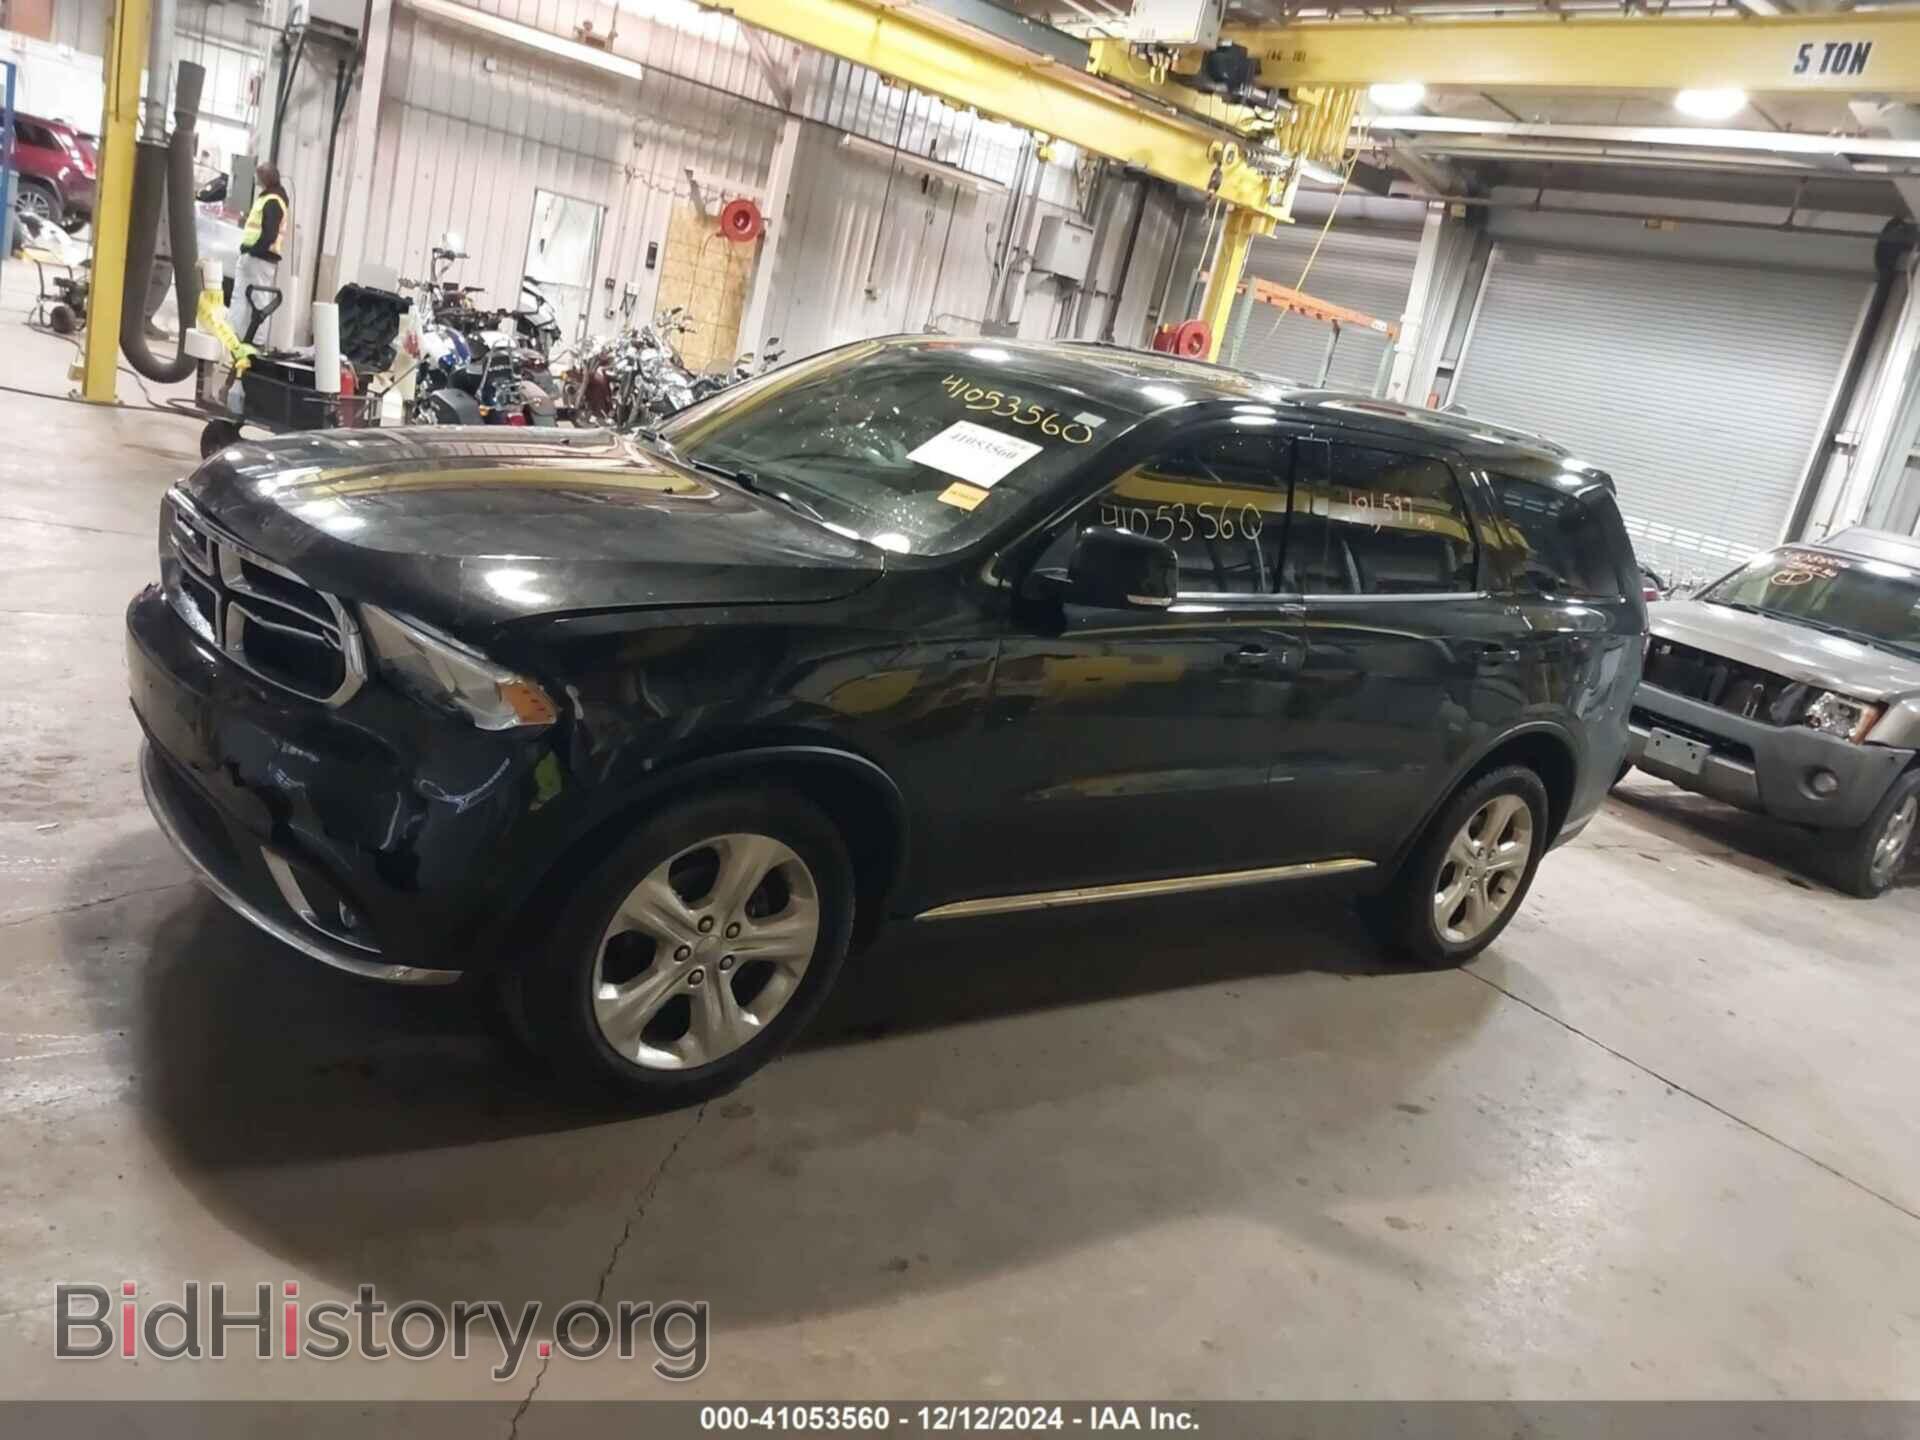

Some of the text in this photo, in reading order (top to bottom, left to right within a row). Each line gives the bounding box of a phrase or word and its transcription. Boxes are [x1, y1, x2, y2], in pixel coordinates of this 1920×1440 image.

[1793, 42, 1872, 75] 5 TON
[942, 374, 1093, 444] 41053560
[1101, 501, 1263, 543] 41053560
